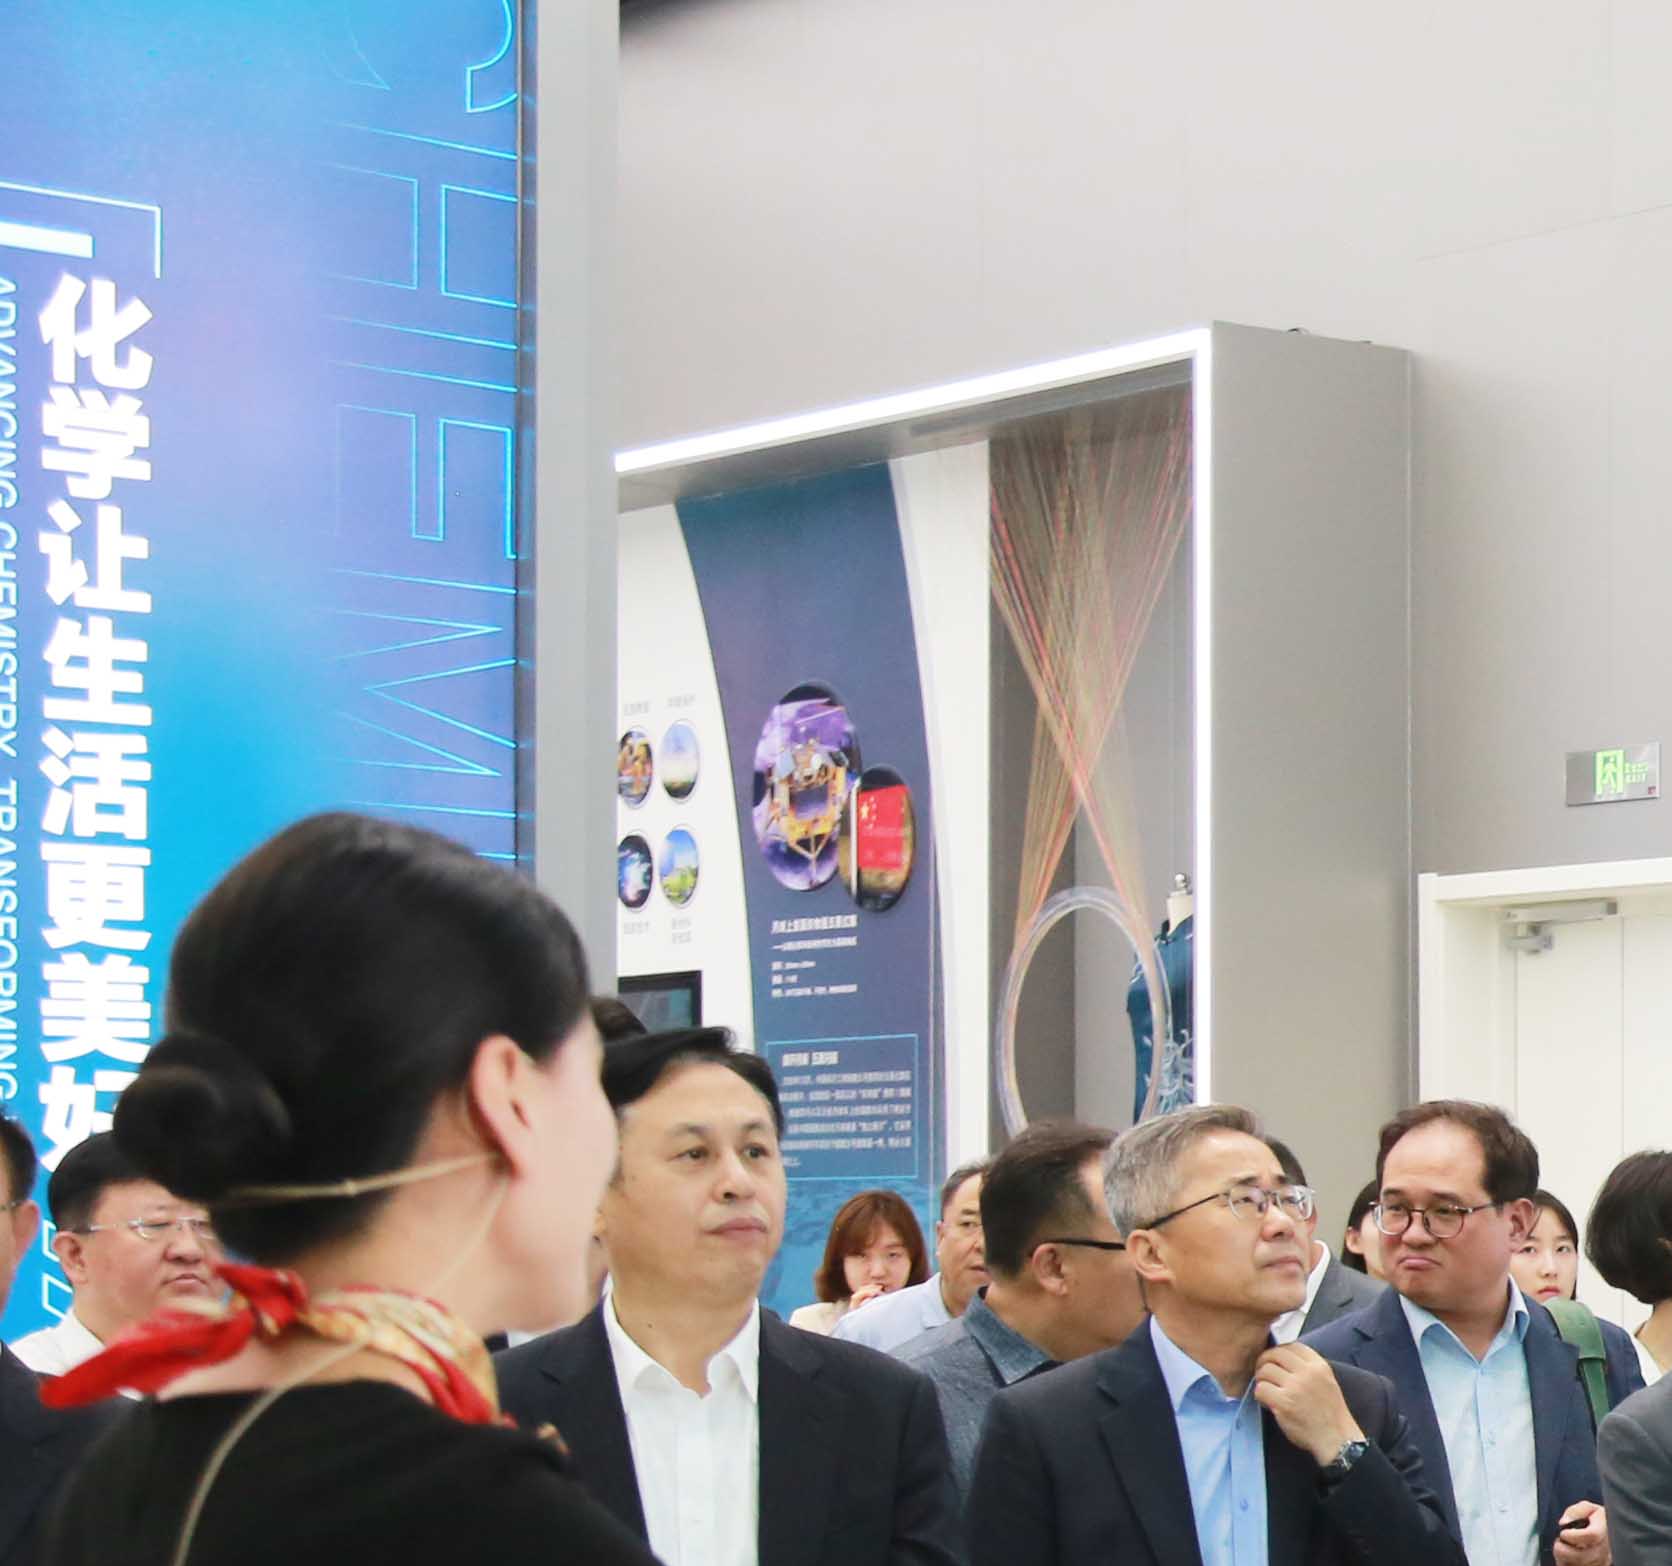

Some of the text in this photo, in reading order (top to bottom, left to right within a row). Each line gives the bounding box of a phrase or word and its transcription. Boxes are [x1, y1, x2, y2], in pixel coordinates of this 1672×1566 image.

[38, 271, 153, 1173] 化学让生活更美好
